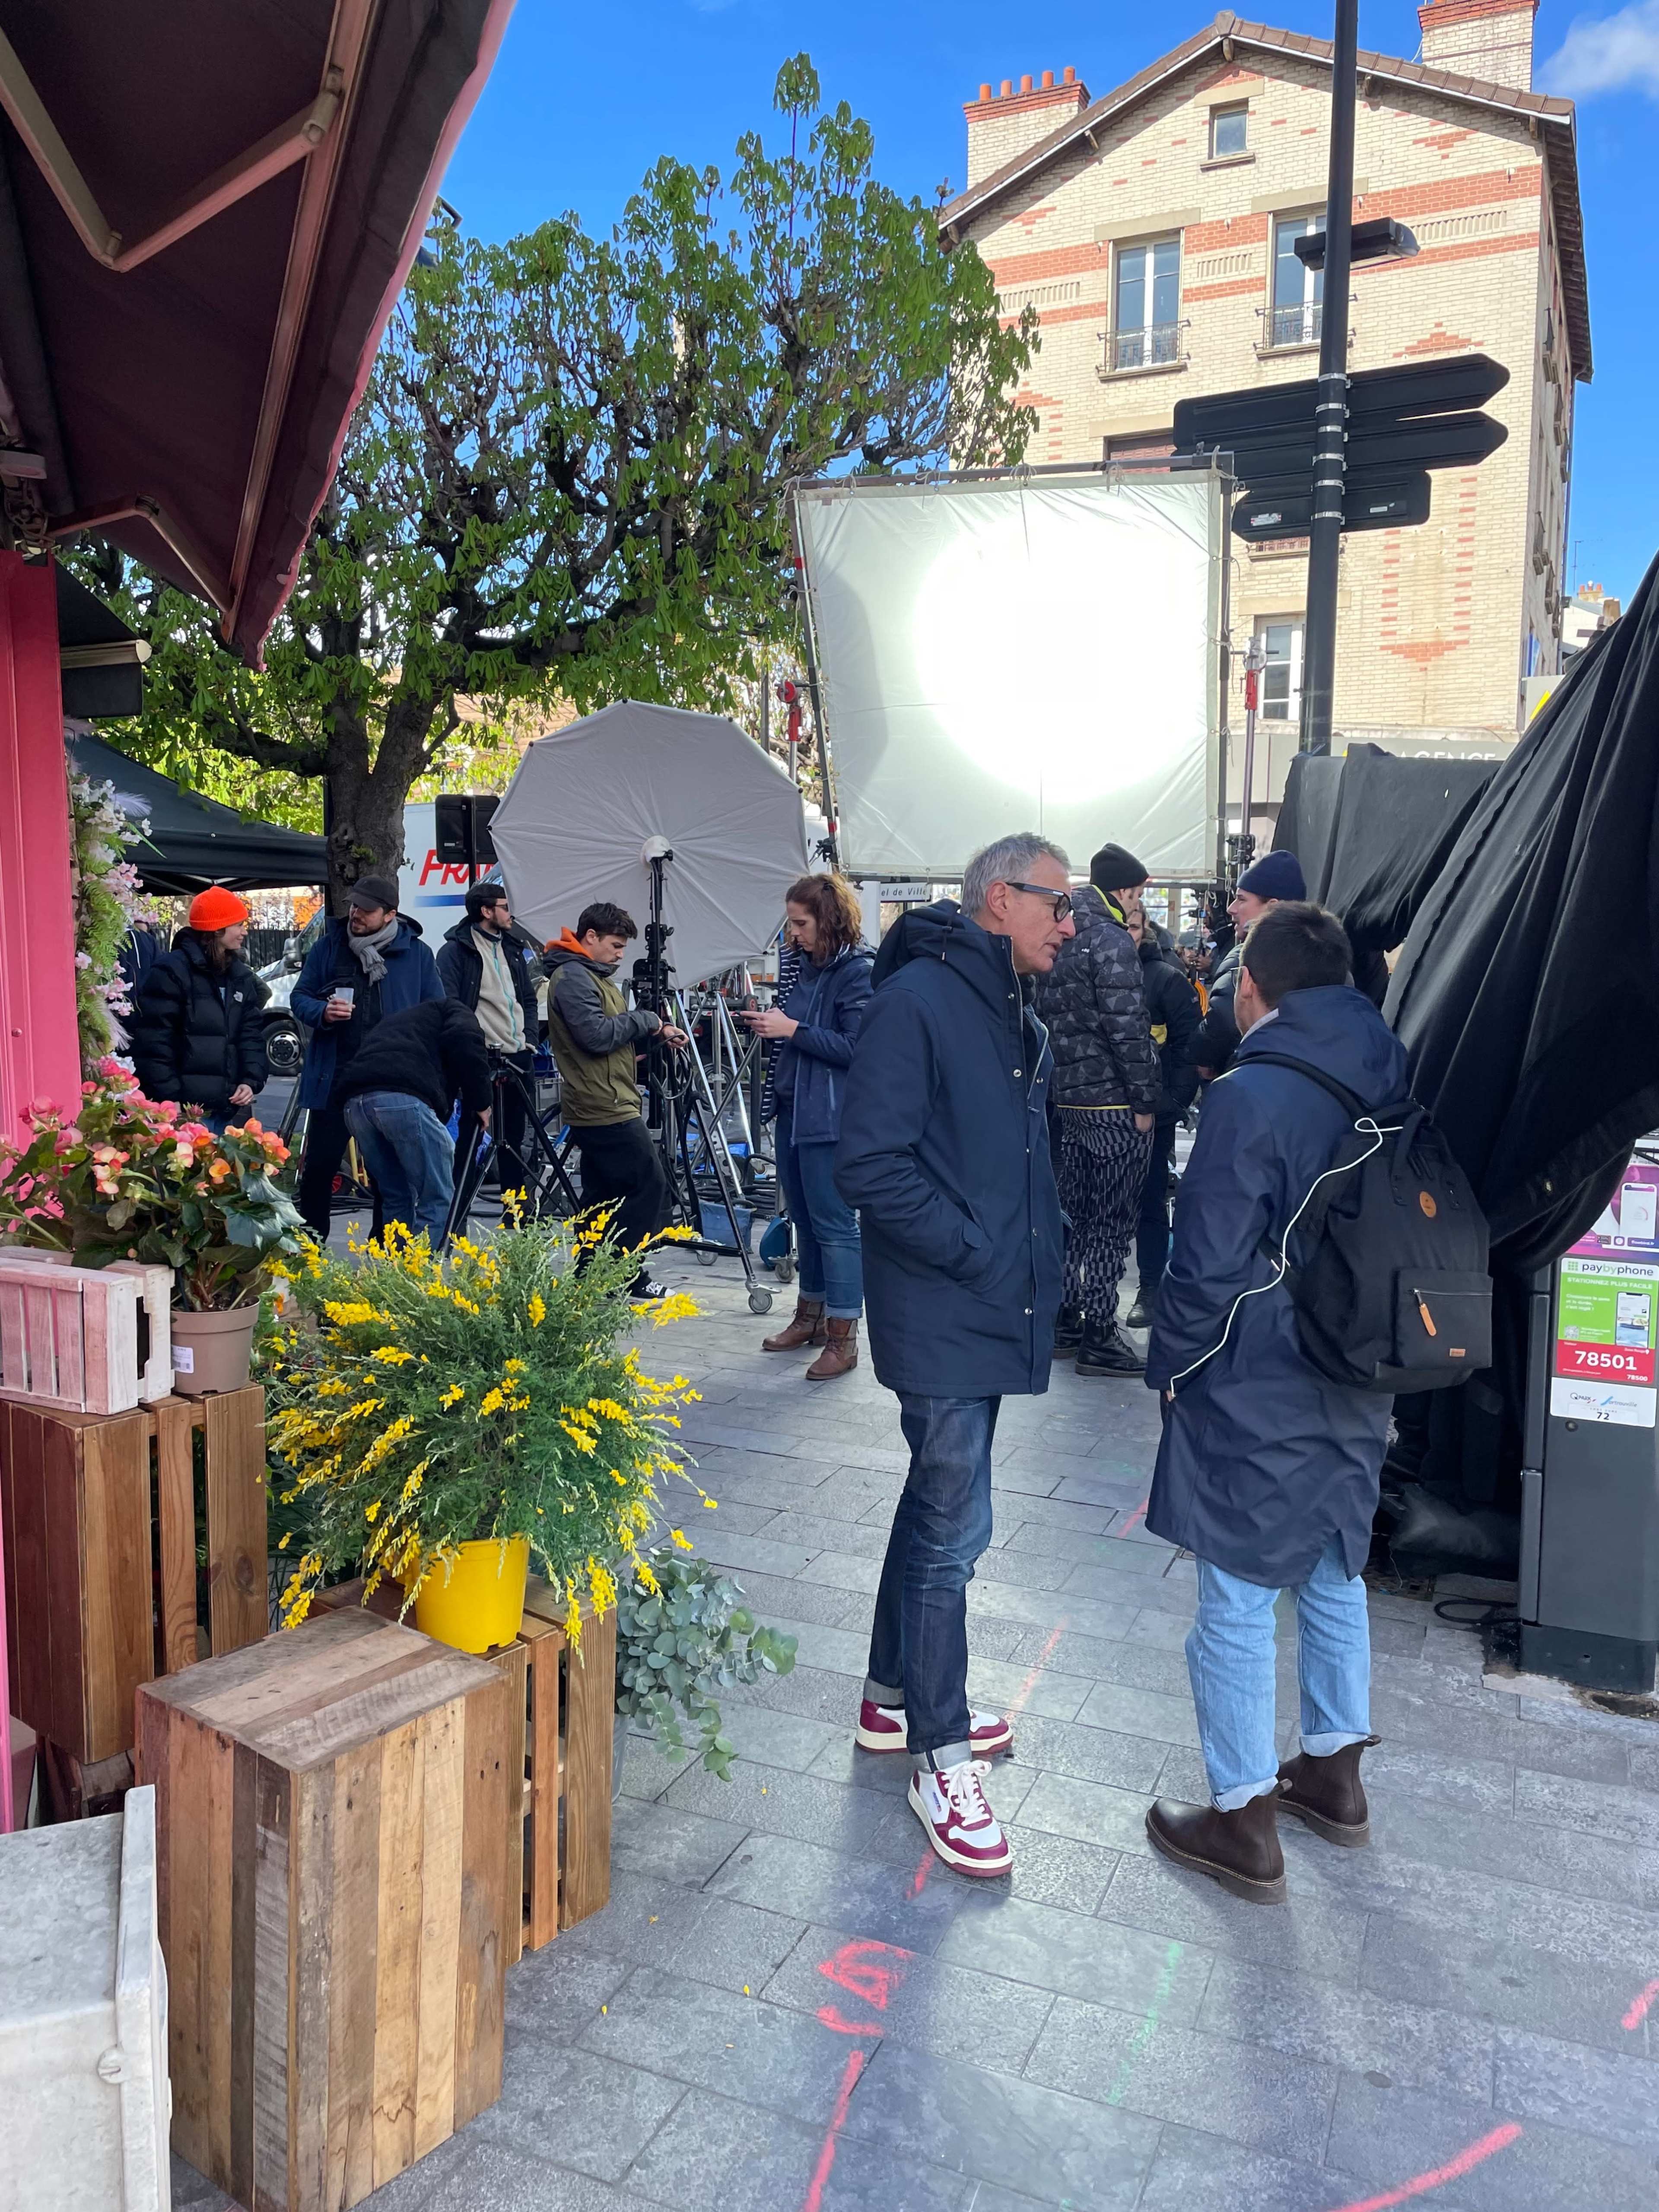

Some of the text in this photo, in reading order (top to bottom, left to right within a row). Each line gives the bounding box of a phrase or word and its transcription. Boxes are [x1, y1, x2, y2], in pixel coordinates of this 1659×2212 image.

[908, 887, 926, 895] Ville
[1582, 1264, 1653, 1276] paybyphone
[1567, 1277, 1609, 1285] STATIONNEZ
[1575, 1351, 1637, 1370] 78501
[1597, 1411, 1609, 1420] 72
